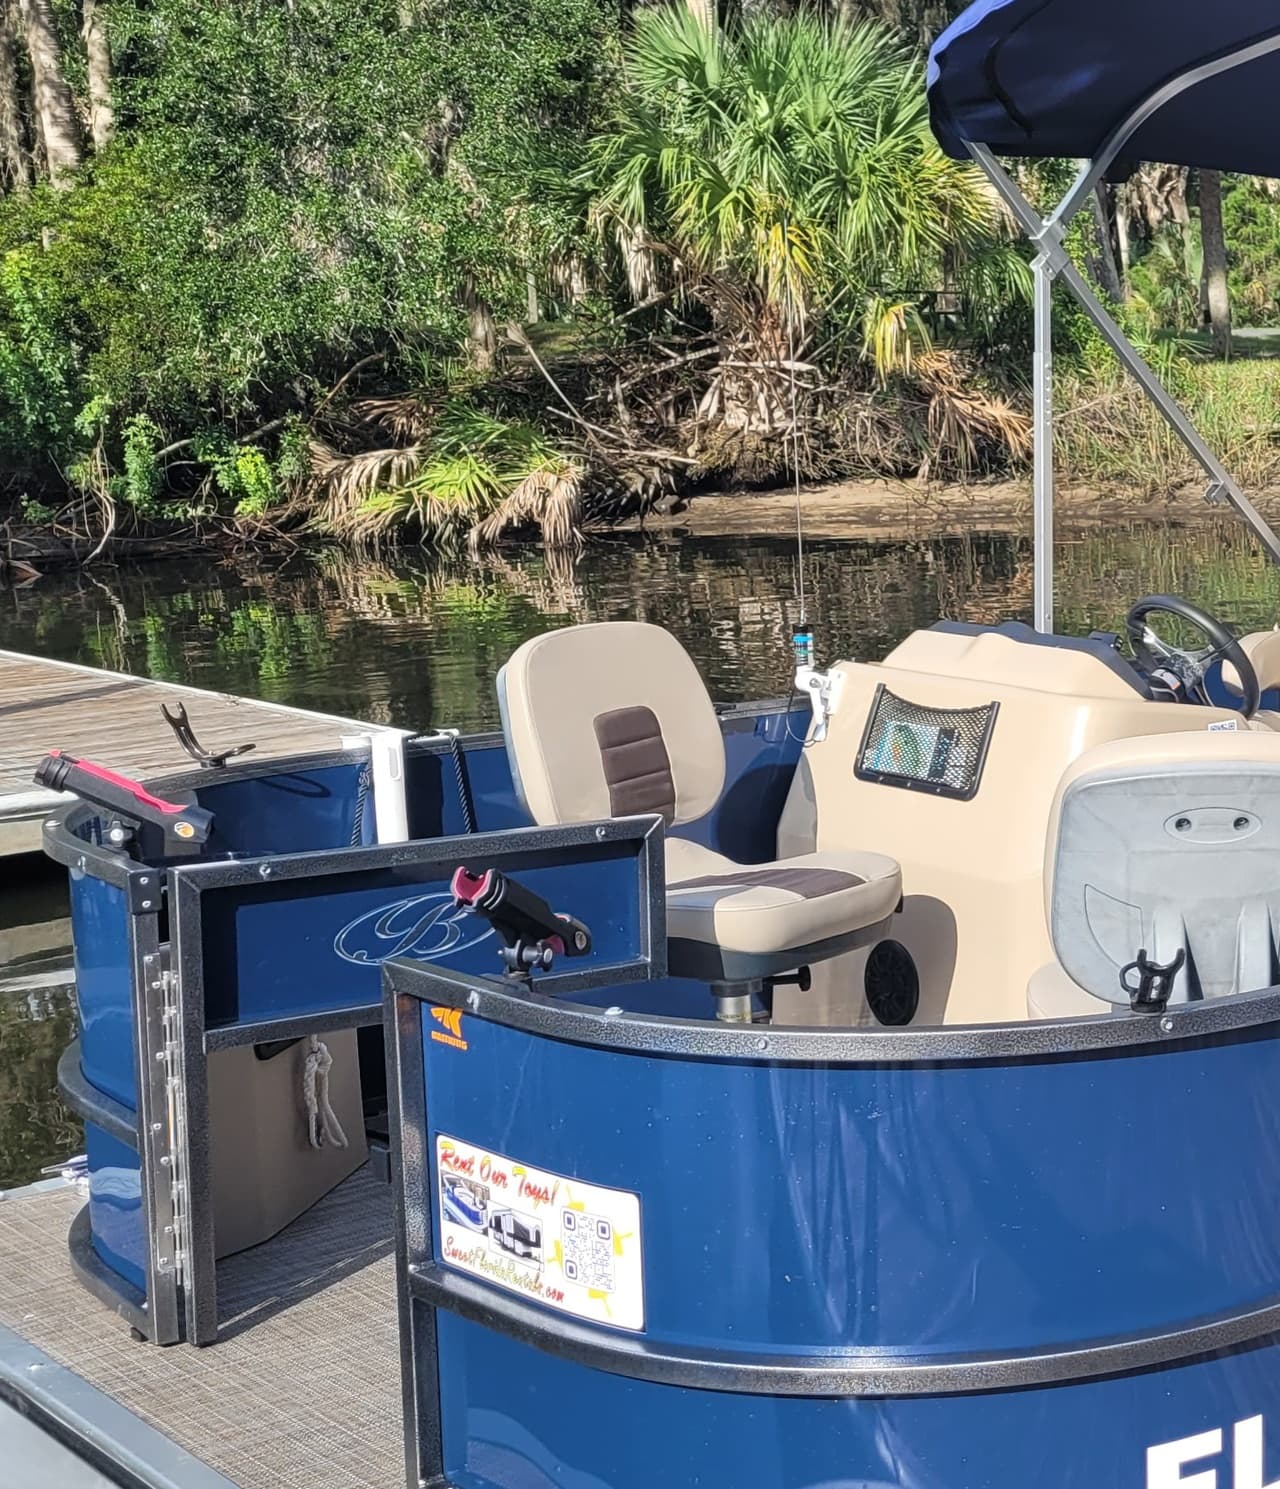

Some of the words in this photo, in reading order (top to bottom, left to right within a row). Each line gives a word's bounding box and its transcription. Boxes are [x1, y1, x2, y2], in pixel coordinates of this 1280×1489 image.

[440, 1141, 475, 1176] Rent
[480, 1155, 509, 1189] Our
[512, 1166, 561, 1210] Toys!
